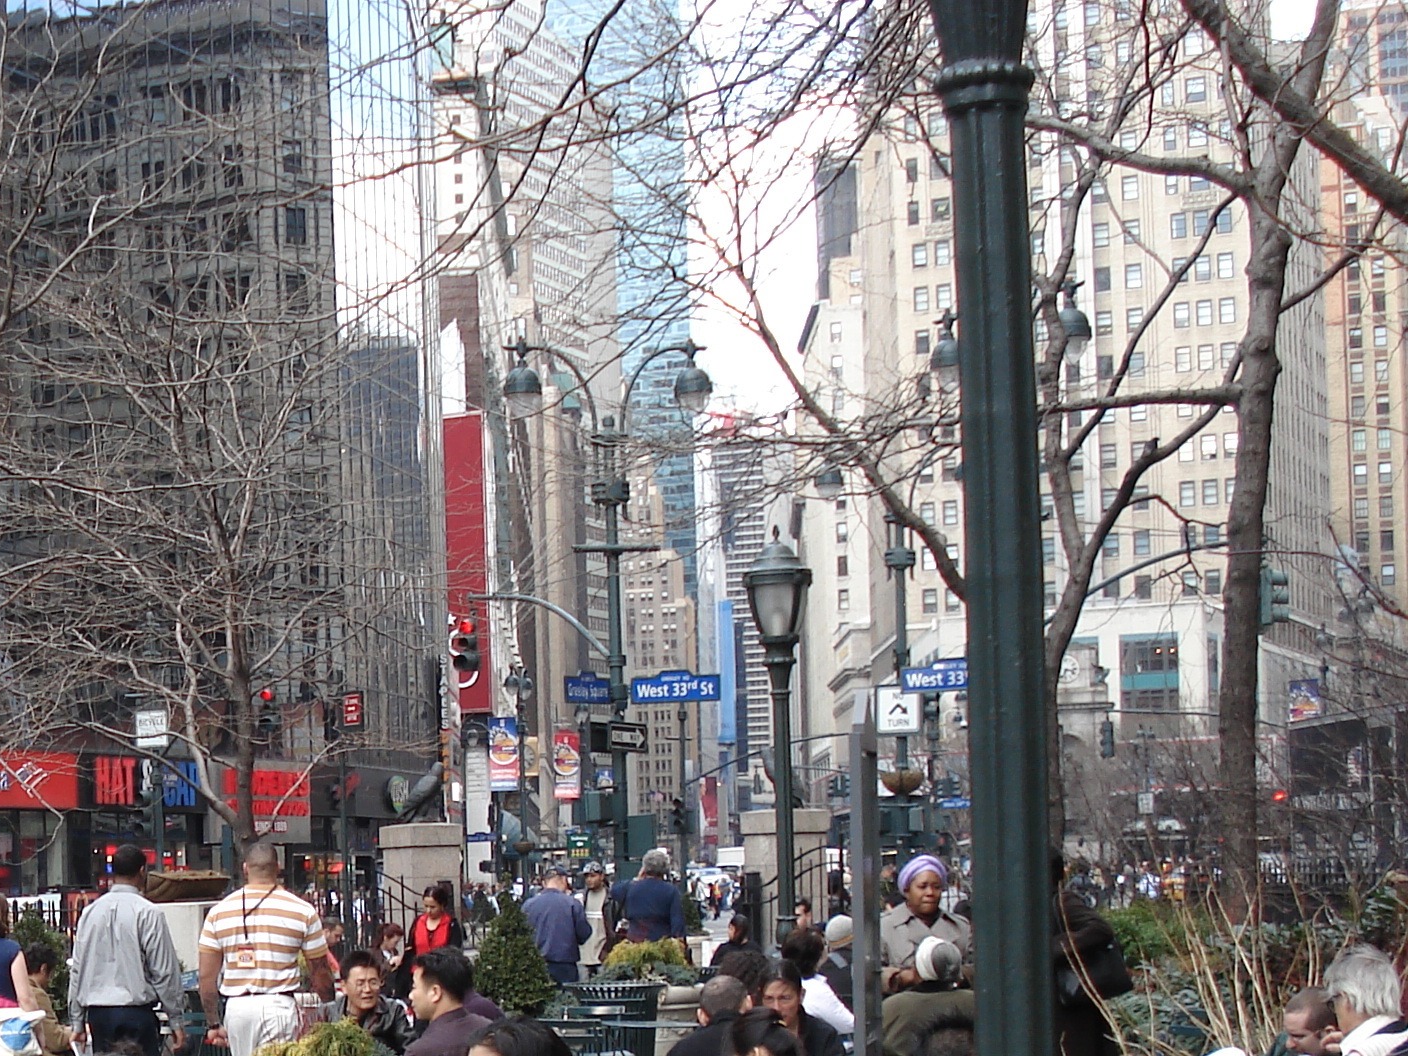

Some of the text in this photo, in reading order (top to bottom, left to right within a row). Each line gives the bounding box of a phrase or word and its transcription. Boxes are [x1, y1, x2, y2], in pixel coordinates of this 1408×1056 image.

[906, 670, 968, 688] West 33
[637, 680, 713, 697] West 33rd St
[888, 718, 909, 727] TURN
[96, 756, 136, 804] HAT
